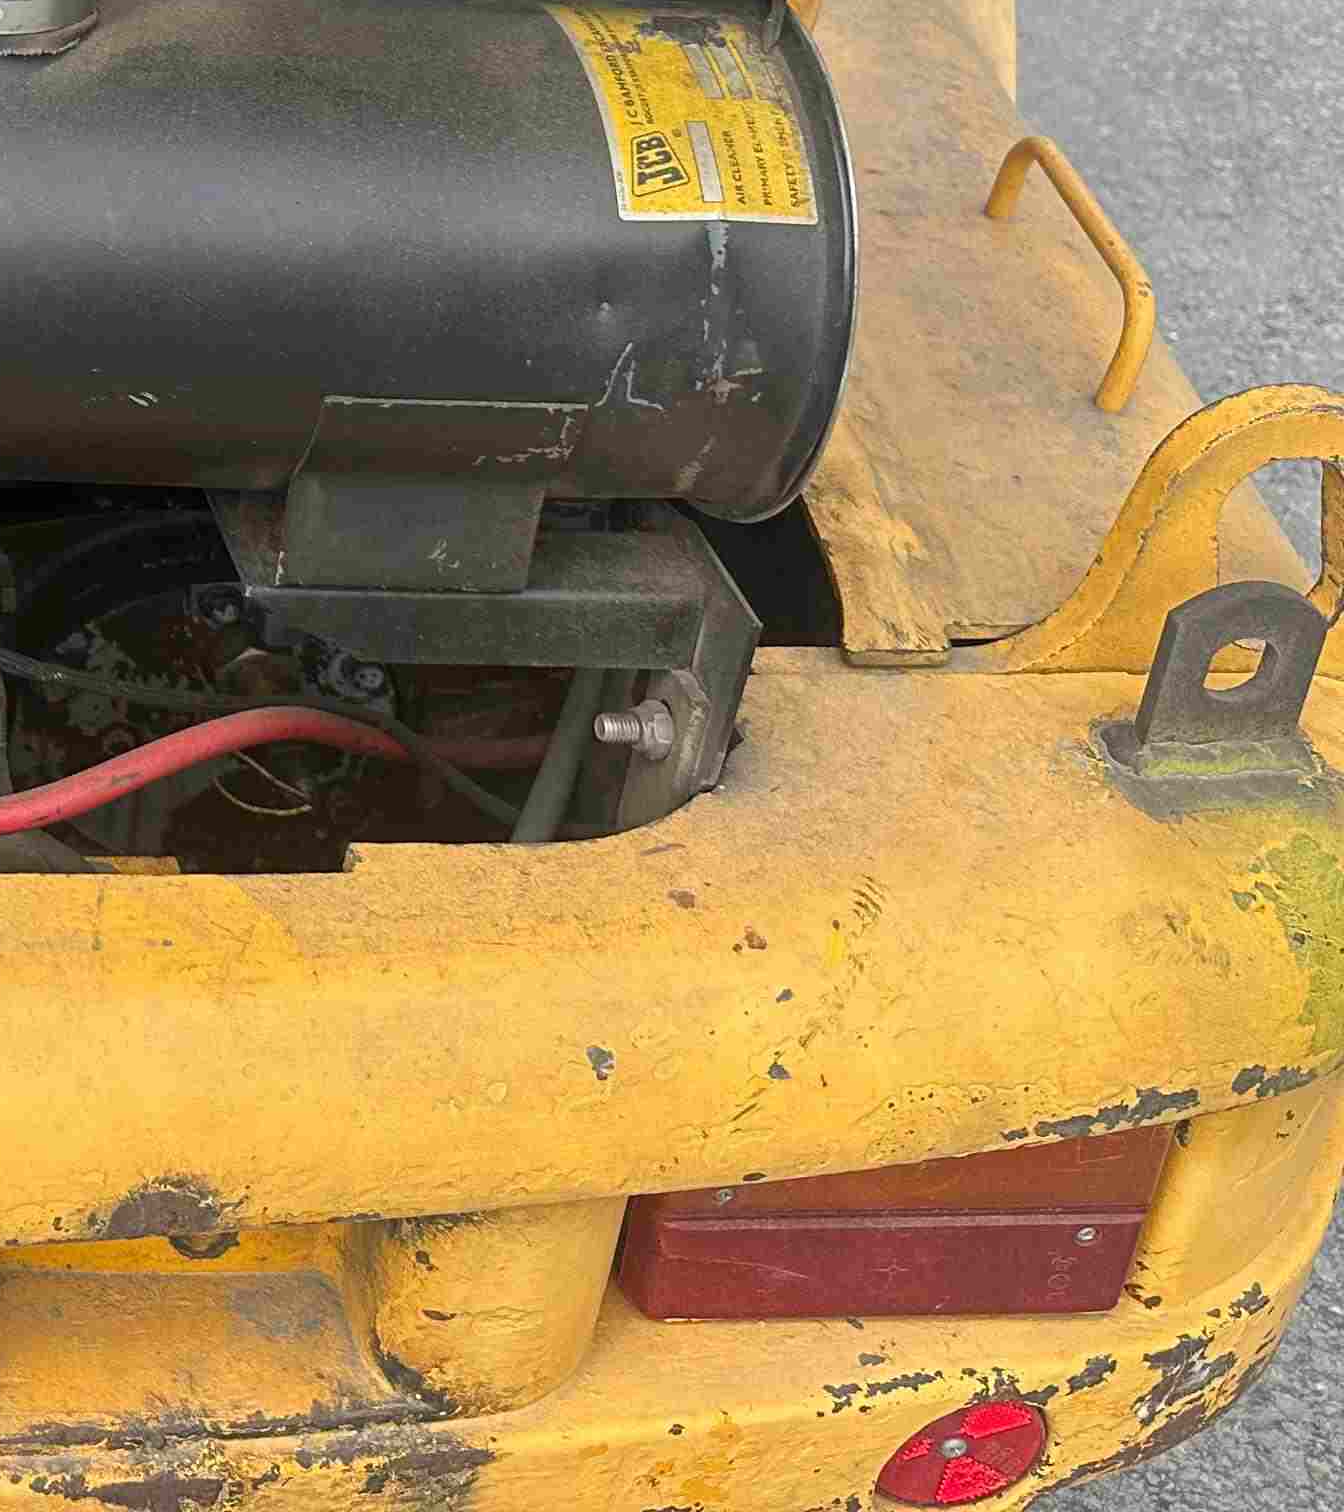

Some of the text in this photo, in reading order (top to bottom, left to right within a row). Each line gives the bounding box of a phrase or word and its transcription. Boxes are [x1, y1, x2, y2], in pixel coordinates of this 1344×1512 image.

[634, 136, 685, 186] JCB
[721, 129, 747, 205] AIR CLEANER
[754, 155, 773, 207] PRIMARY
[783, 161, 801, 208] SAFETY
